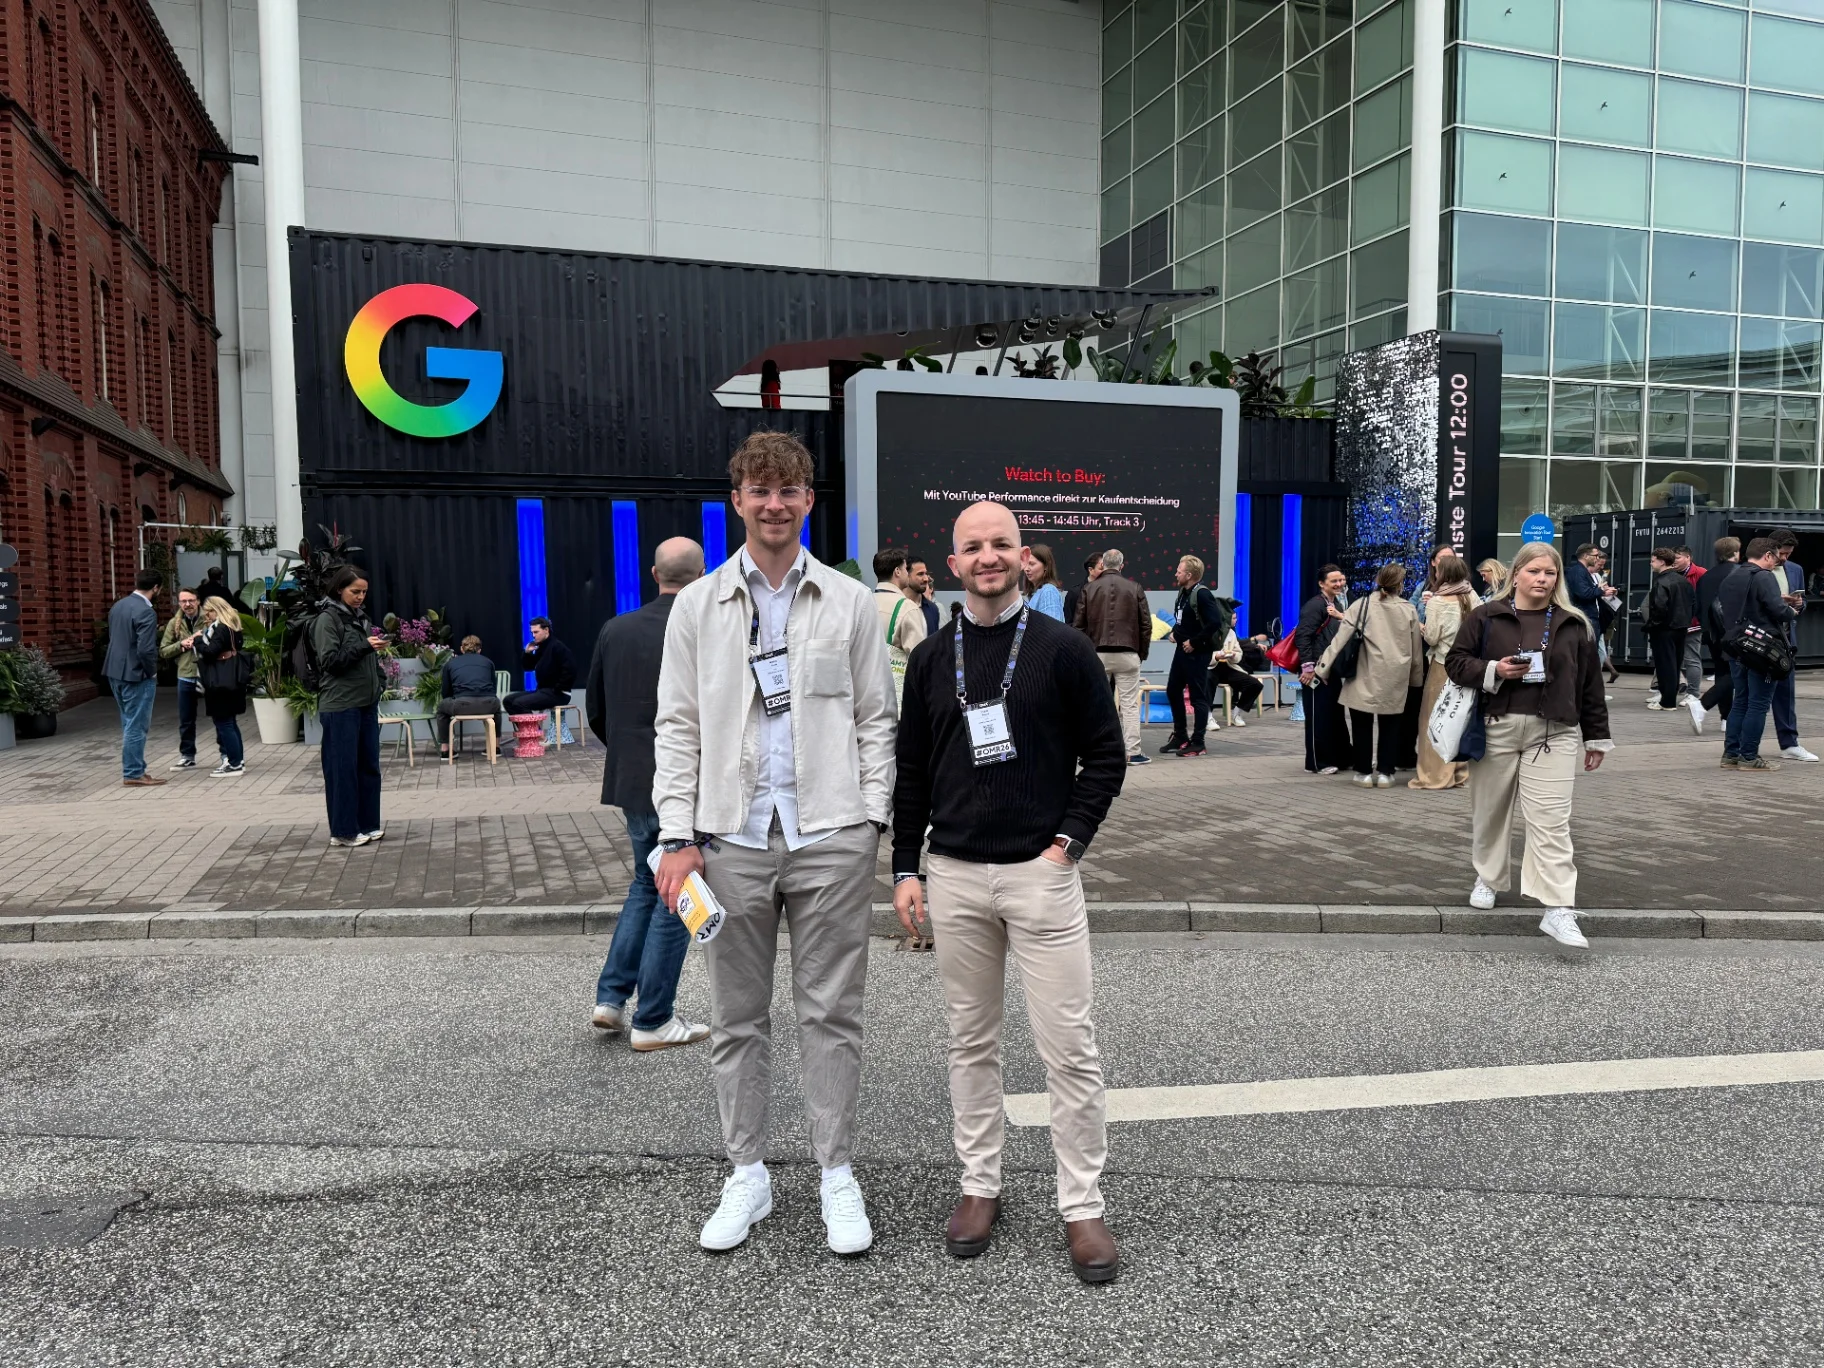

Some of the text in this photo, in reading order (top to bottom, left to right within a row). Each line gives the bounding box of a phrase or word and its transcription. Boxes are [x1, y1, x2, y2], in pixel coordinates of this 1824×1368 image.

[344, 283, 504, 438] G
[1450, 373, 1469, 440] 12:00
[1005, 466, 1106, 486] Watch to Buy:
[1449, 445, 1467, 501] Tour
[923, 489, 1180, 508] Mit YouTube Performance direkt zur Kaufentscheidung
[1018, 514, 1045, 525] 13:45
[1053, 515, 1079, 526] 14:45
[1081, 515, 1102, 527] Uhr,
[1103, 516, 1131, 527] Track
[1132, 517, 1140, 527] 3
[976, 743, 1010, 757] #OMR26
